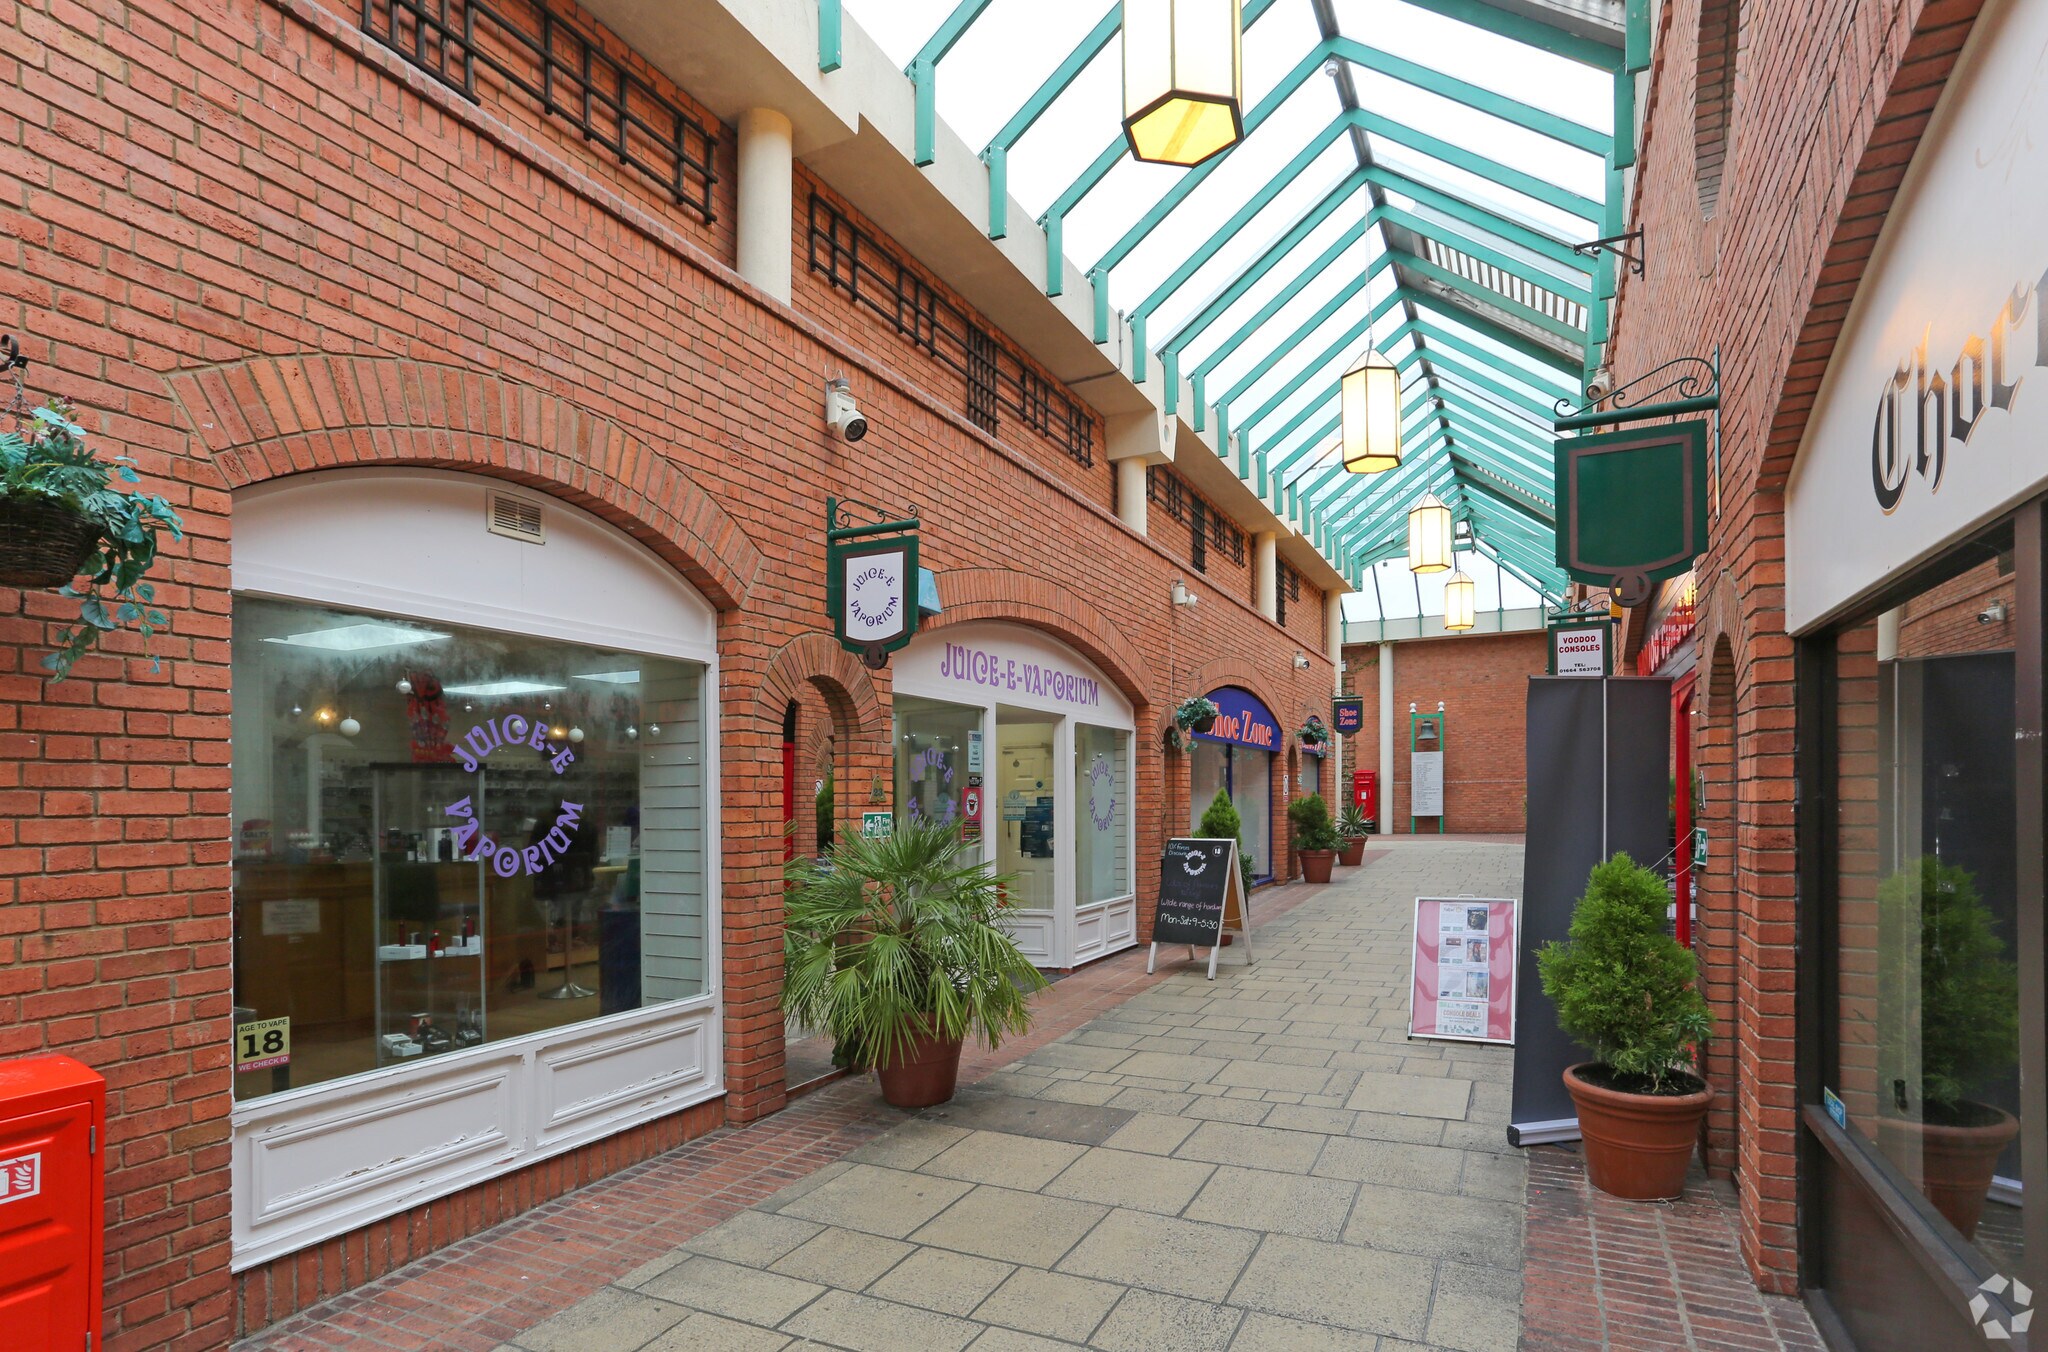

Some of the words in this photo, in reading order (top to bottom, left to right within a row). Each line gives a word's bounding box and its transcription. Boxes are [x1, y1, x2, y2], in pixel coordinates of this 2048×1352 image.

[1872, 262, 2048, 517] Choc
[852, 567, 895, 591] JUICE-E
[850, 596, 898, 627] VAPORIUM
[1559, 644, 1600, 653] CONSOLES
[1563, 635, 1596, 644] VOODOO
[941, 642, 1099, 706] JUICE-E-VAPORIUM
[1339, 708, 1357, 717] Shoe
[1339, 717, 1357, 725] Zone
[1242, 710, 1273, 746] Zone
[453, 714, 575, 774] JUICE-E
[1090, 761, 1114, 786] JUICE-E
[1089, 797, 1115, 831] VAPORIUM
[444, 795, 584, 878] VAPORIUM
[1178, 902, 1194, 910] range
[239, 1024, 255, 1032] AGE
[268, 1019, 287, 1027] VAPE
[243, 1029, 284, 1058] 18
[252, 1058, 279, 1068] CHECK
